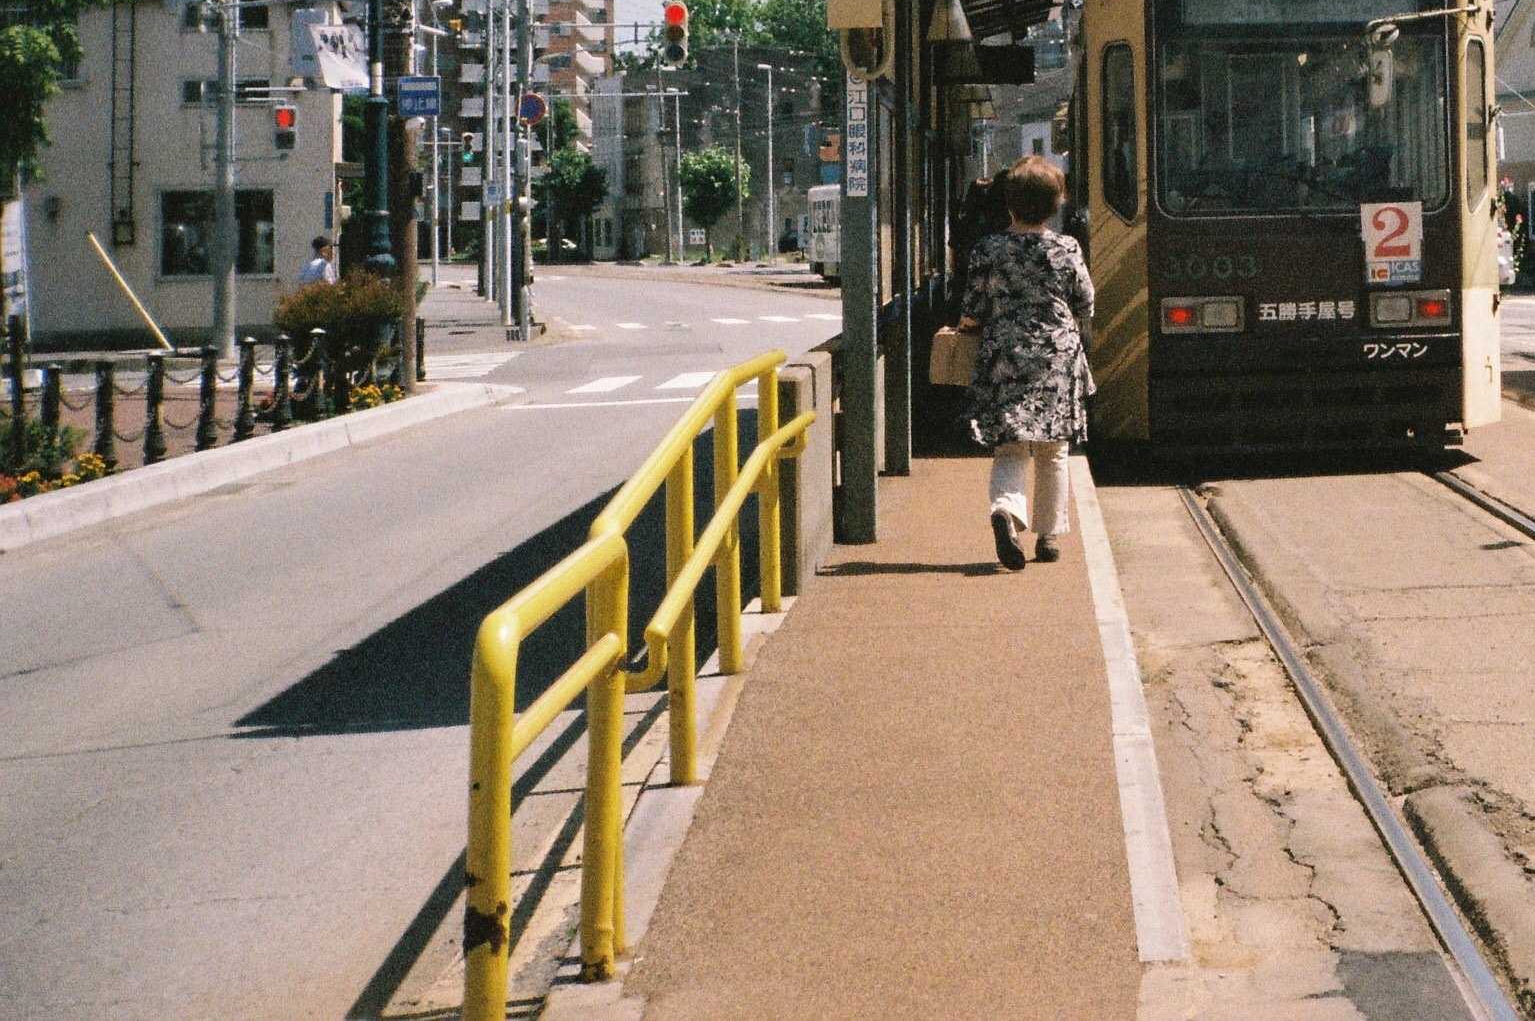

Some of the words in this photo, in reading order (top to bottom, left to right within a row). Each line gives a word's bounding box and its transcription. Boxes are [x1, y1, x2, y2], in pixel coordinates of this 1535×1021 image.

[849, 89, 866, 191] 江口眼科病院
[1372, 206, 1411, 257] 2
[1259, 300, 1355, 321] 五勝手屋号
[1363, 342, 1428, 359] ワンマン
